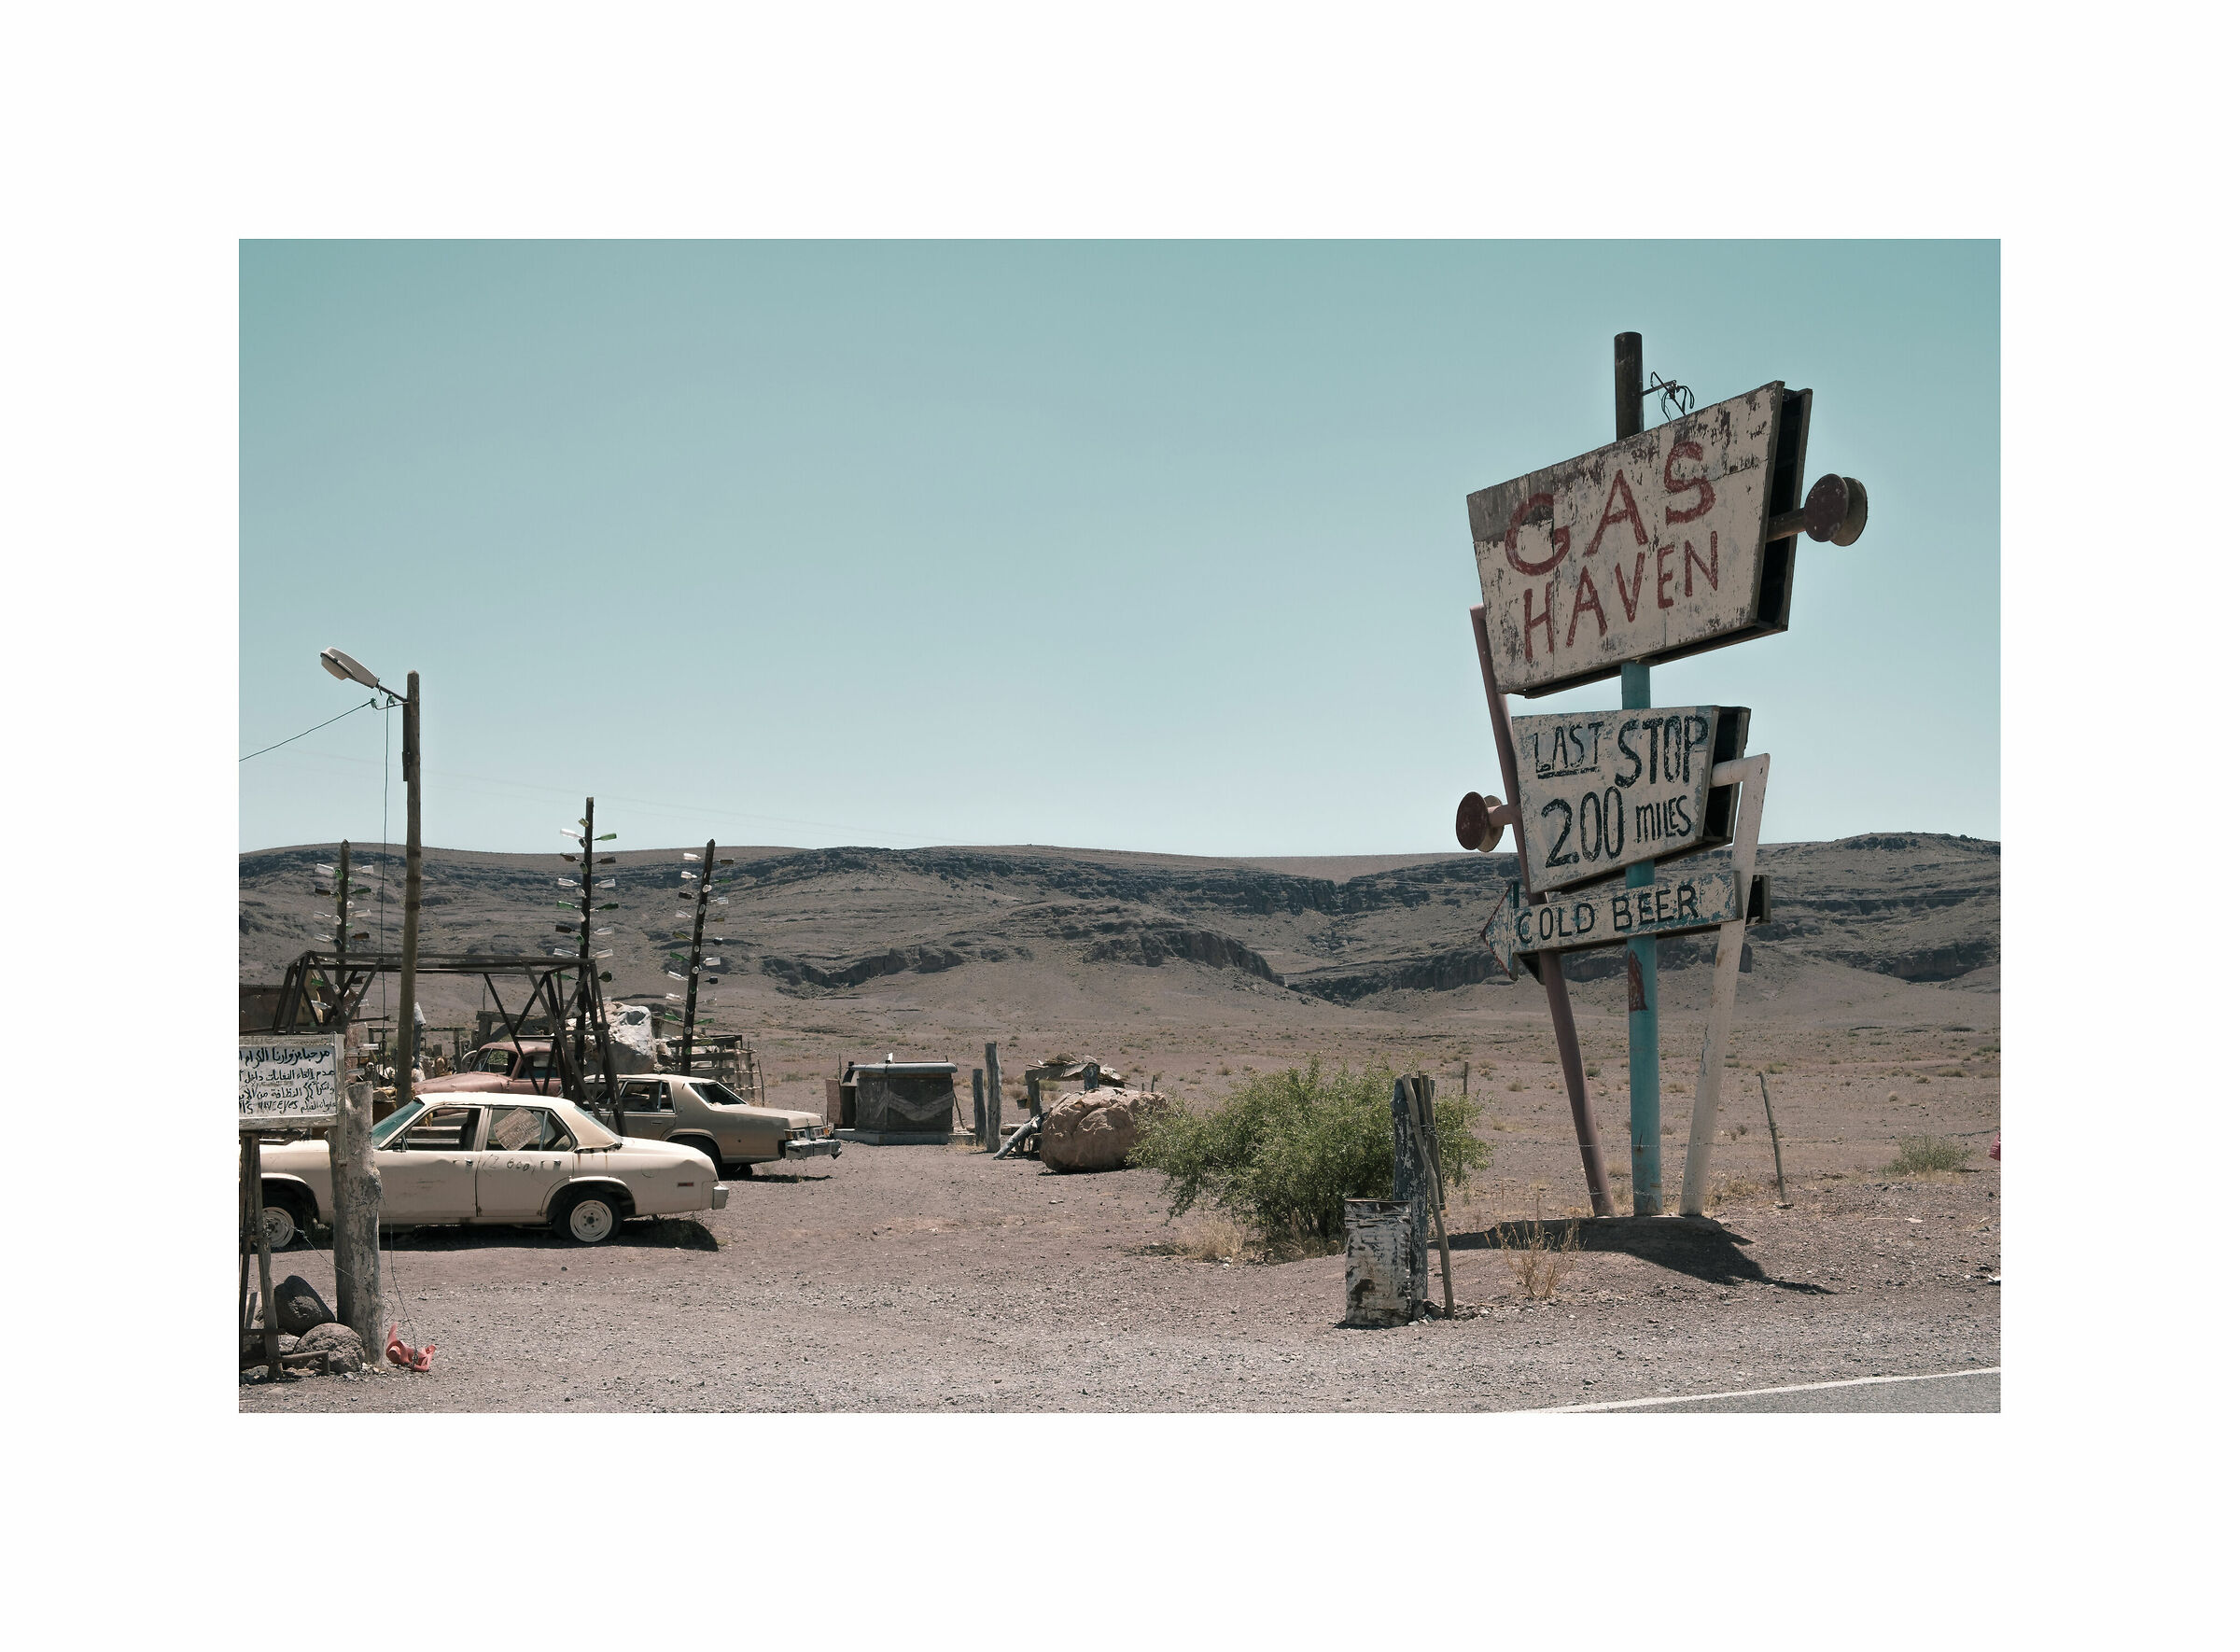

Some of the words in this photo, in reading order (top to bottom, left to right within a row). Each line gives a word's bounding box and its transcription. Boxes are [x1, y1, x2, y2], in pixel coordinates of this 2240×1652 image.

[1505, 441, 1716, 576] GAS
[1524, 530, 1719, 664] HAVEN
[1533, 721, 1603, 774] LAST
[1614, 715, 1710, 789] STOP
[1517, 902, 1596, 945] COLD
[1612, 884, 1700, 932] BEER
